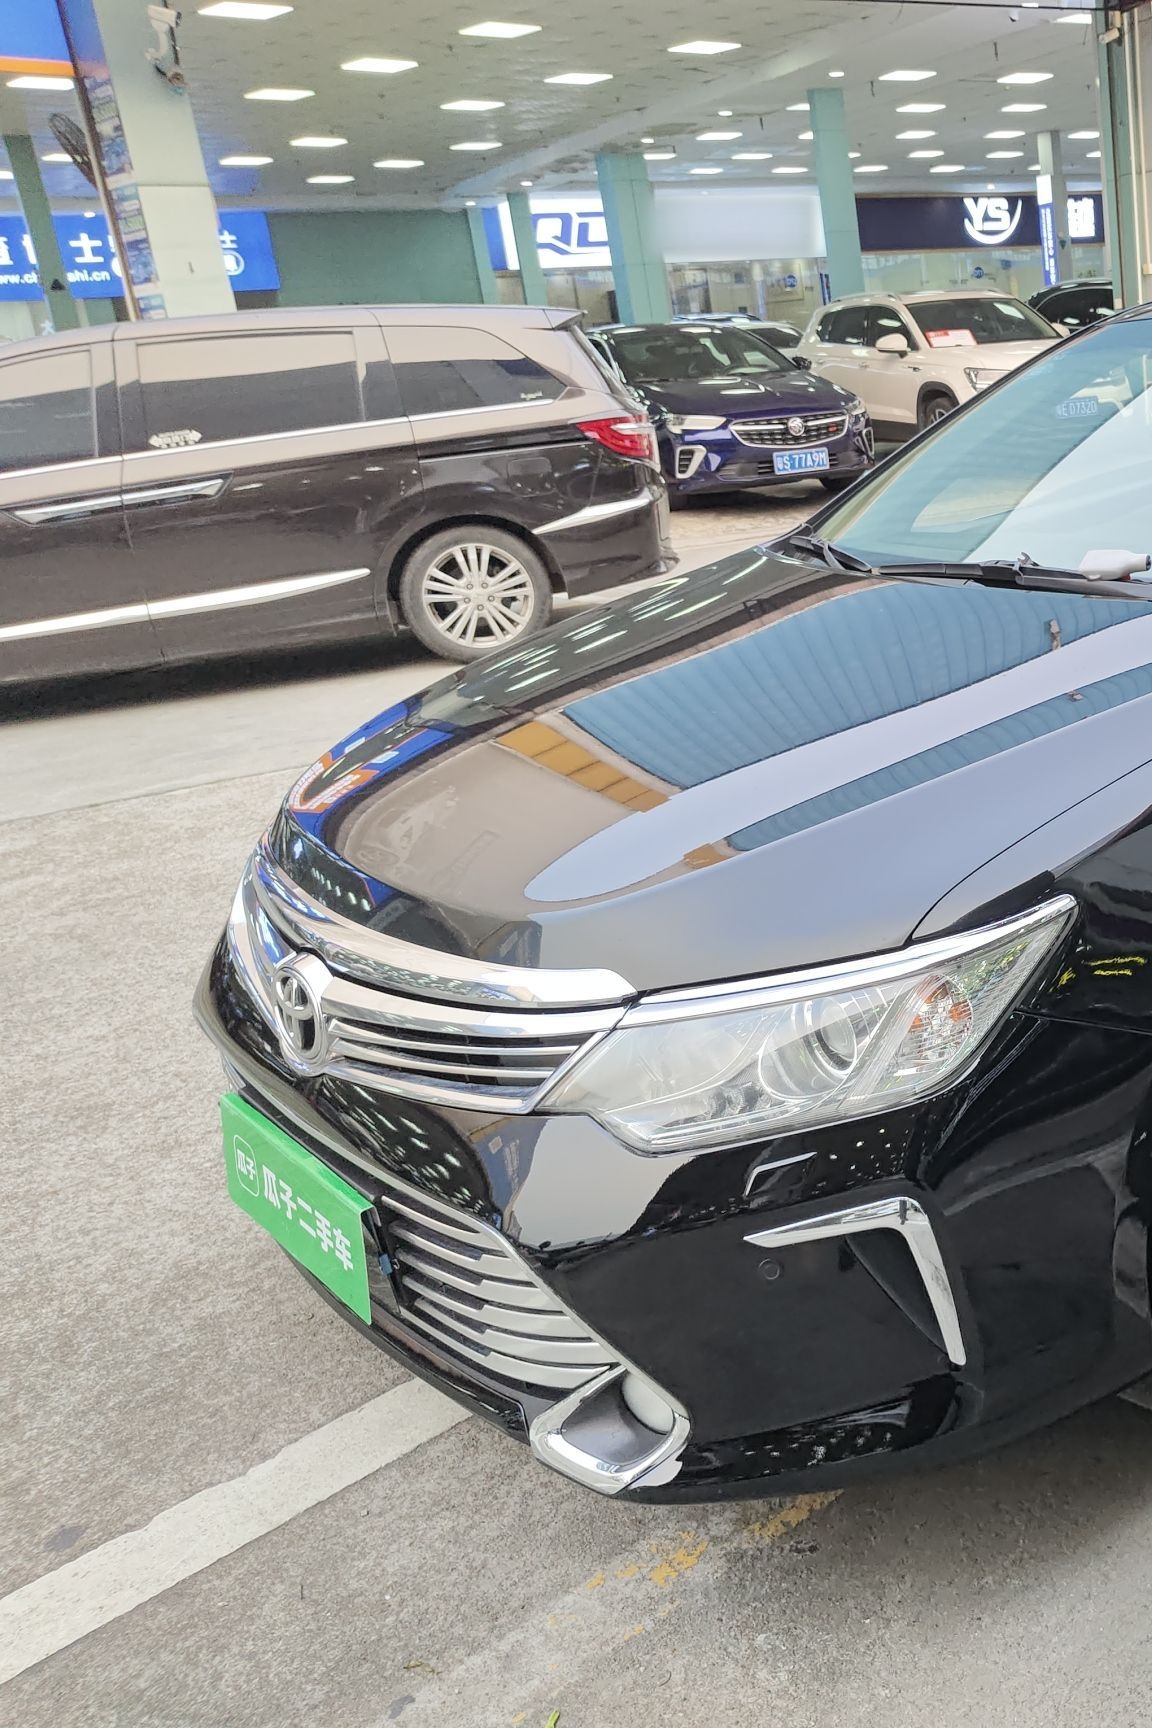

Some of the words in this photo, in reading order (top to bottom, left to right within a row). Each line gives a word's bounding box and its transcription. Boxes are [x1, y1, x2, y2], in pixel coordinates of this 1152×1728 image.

[963, 197, 1011, 231] YS
[236, 1149, 256, 1181] 瓜子
[262, 1164, 354, 1271] 瓜子二手车
